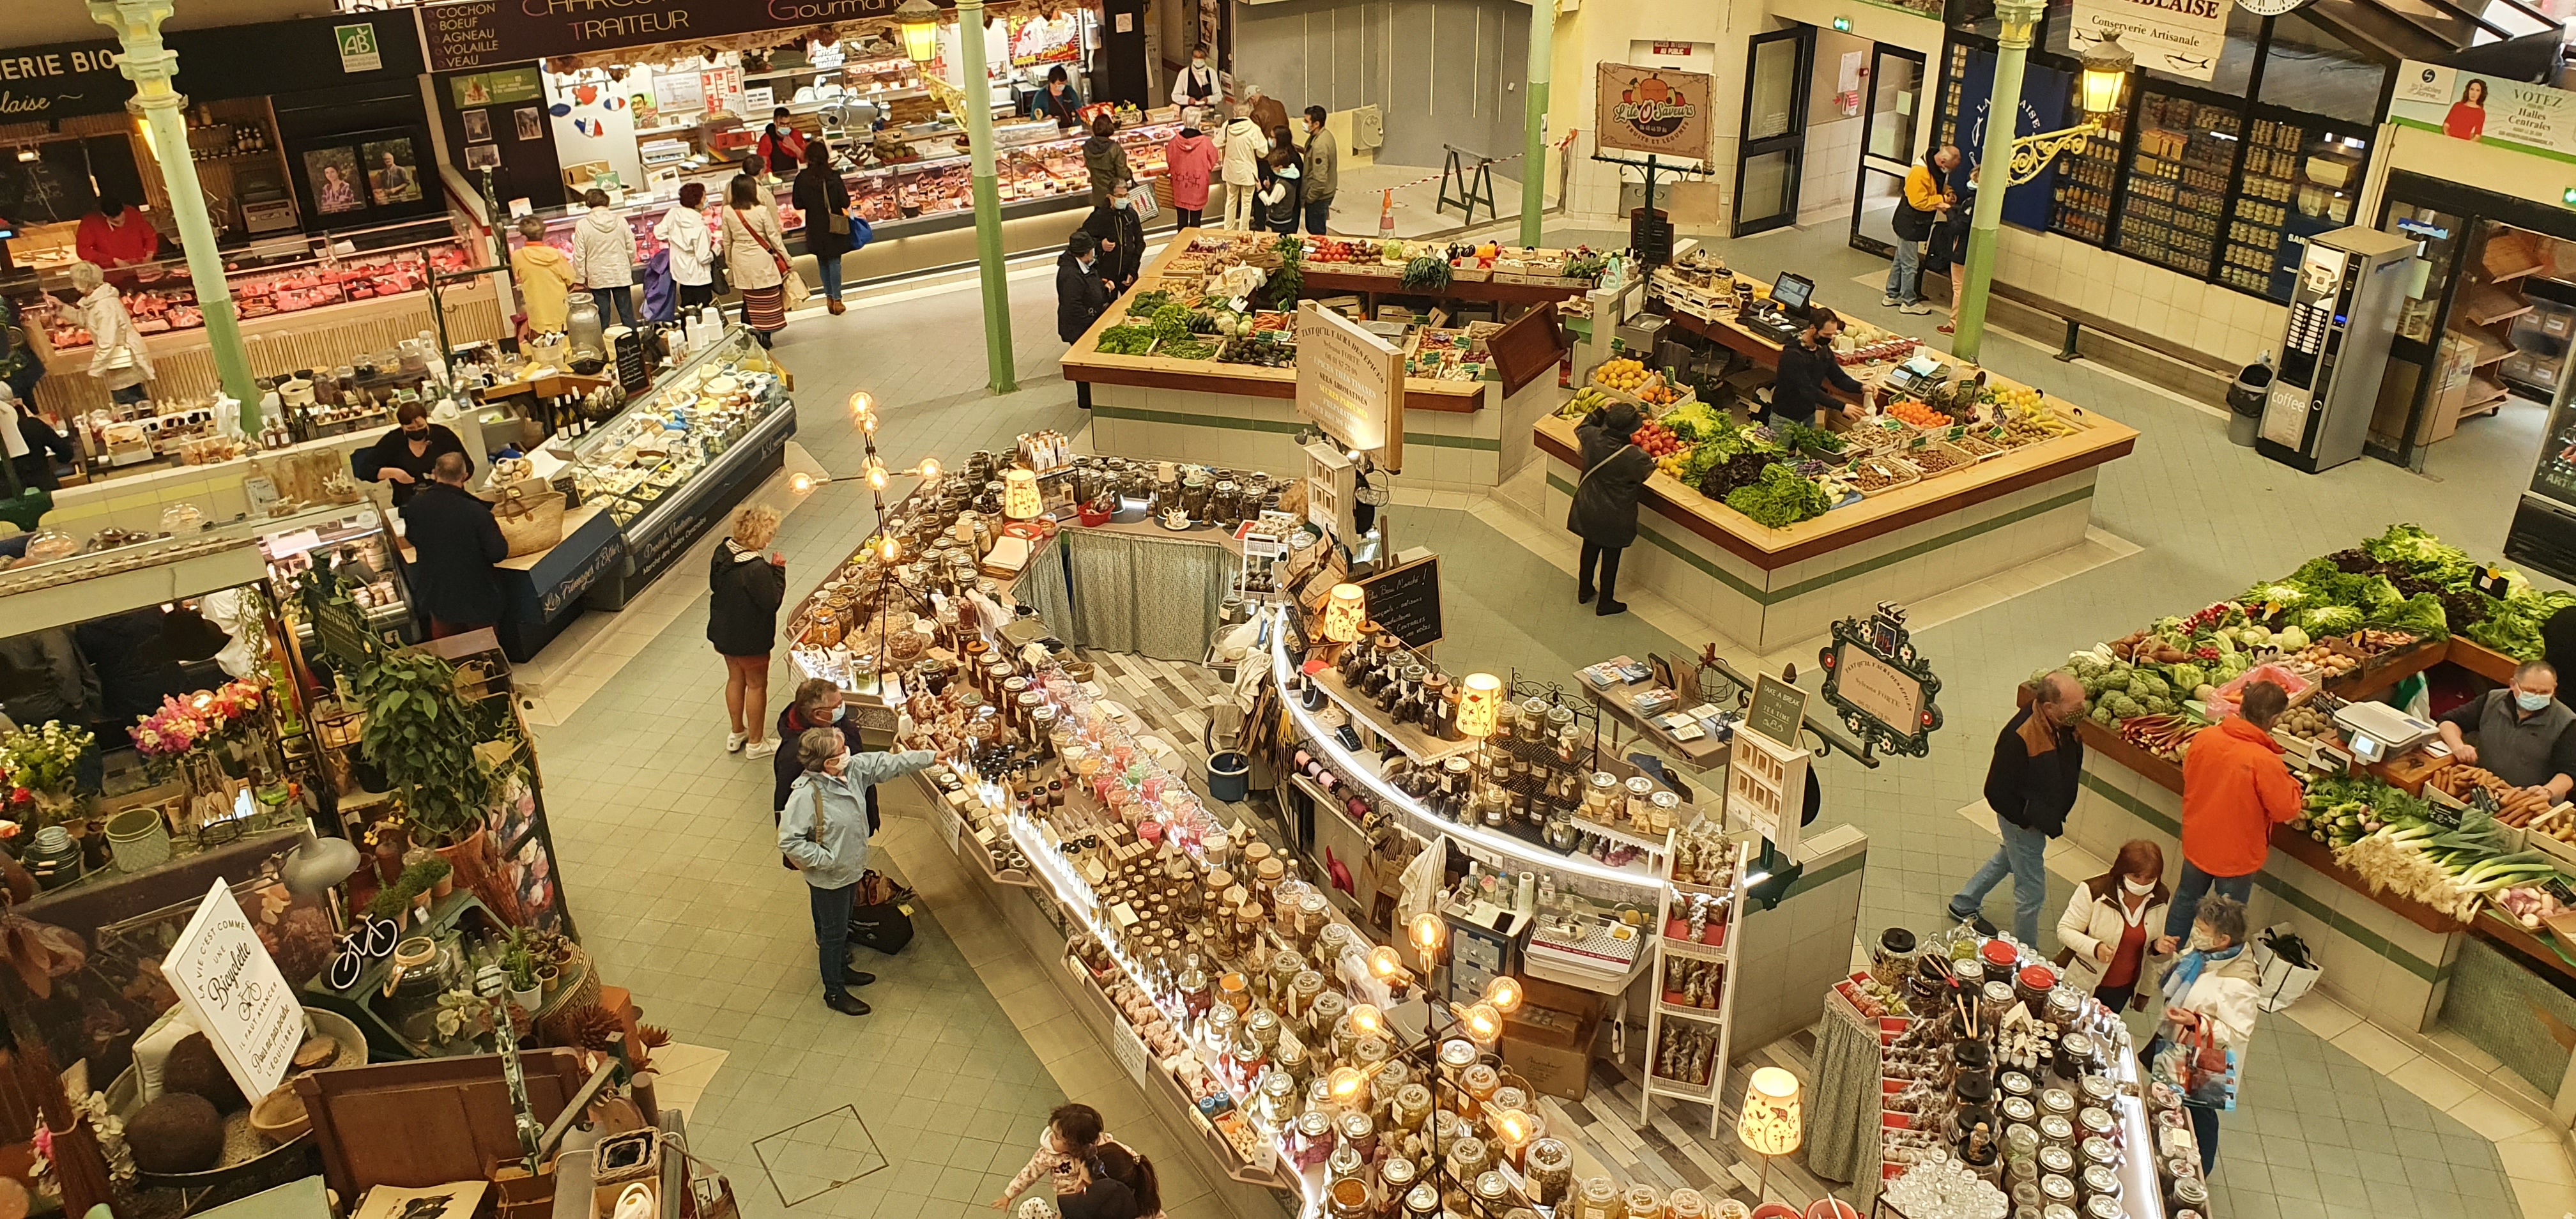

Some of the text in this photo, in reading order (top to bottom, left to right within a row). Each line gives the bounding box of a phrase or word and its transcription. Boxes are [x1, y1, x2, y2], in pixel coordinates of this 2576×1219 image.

[436, 3, 496, 19] COCHON
[2126, 0, 2220, 19] BLAISE
[440, 17, 478, 31] BOEUF
[568, 10, 689, 40] TRAITEUR
[2092, 15, 2200, 47] Conserverie Artisanale
[344, 34, 370, 55] AB
[442, 29, 494, 43] AGNEAU
[444, 40, 499, 55] VOLAILLE
[71, 49, 116, 72] BIO
[446, 55, 479, 68] VEAU
[2514, 89, 2563, 108] VOTEZ
[1653, 103, 1695, 119] Saveurs
[2518, 108, 2546, 120] Halles
[2508, 115, 2551, 131] Centrales
[2288, 233, 2306, 245] SAR
[1301, 327, 1315, 337] TANT
[1335, 332, 1351, 347] AURA
[1351, 343, 1363, 357] DES
[1319, 372, 1333, 385] SELS
[2272, 392, 2305, 413] coffee
[1764, 685, 1776, 696] TAKE
[1783, 694, 1800, 707] BREAK
[217, 920, 245, 931] COMME
[200, 928, 216, 955] C'EST
[213, 945, 226, 964] UNE
[208, 942, 251, 1011] Bicyclette
[198, 984, 205, 999] LA
[239, 981, 277, 1050] IL FAUT AVANCER
